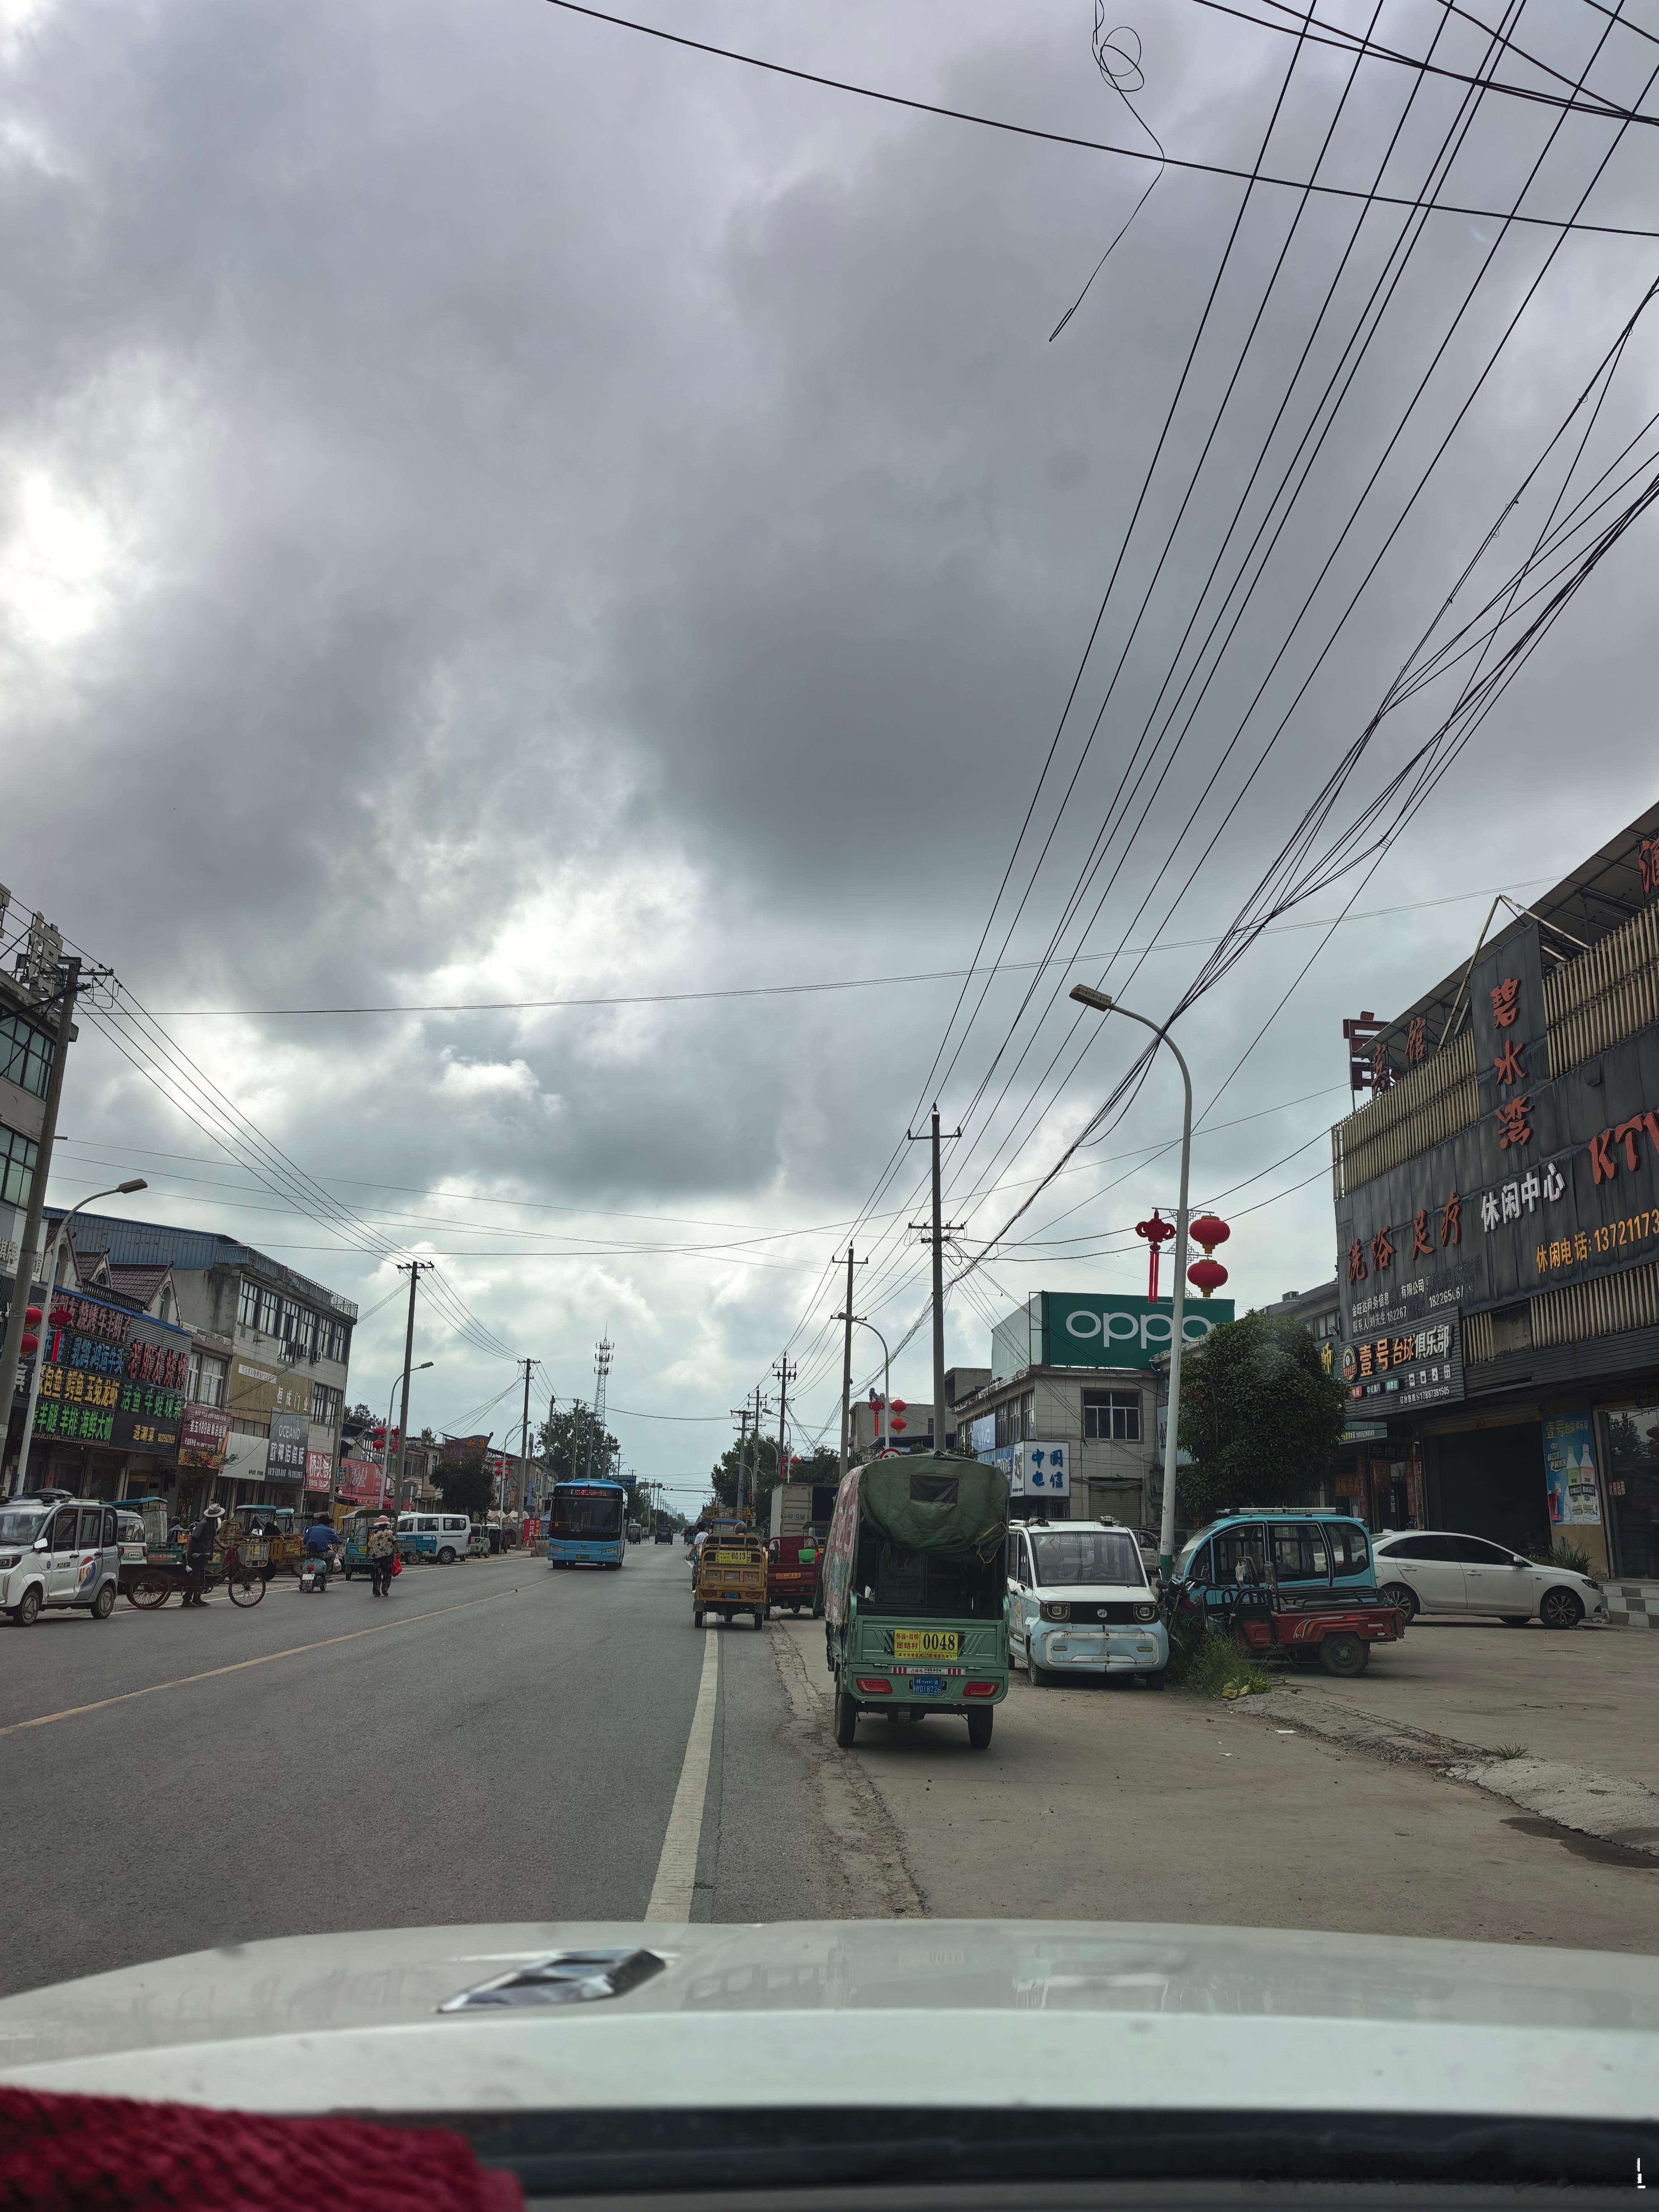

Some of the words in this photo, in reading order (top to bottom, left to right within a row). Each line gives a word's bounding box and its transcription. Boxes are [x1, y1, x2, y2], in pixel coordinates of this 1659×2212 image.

[1490, 978, 1535, 1149] 碧水湾
[1481, 1162, 1565, 1233] 休闲中心
[1346, 1225, 1396, 1283] 洗浴
[1412, 1192, 1463, 1260] 足疗
[1401, 1278, 1424, 1299] 有限公司
[1066, 1310, 1212, 1349] oppo
[1358, 1325, 1450, 1377] 壹号台球俱乐部
[278, 1424, 300, 1440] OCEANO
[978, 1425, 990, 1445] vivo
[269, 1441, 305, 1465] 欧神诺瓷砖
[1031, 1448, 1063, 1469] 中国
[1031, 1470, 1063, 1488] 电信
[923, 1633, 955, 1651] 0048
